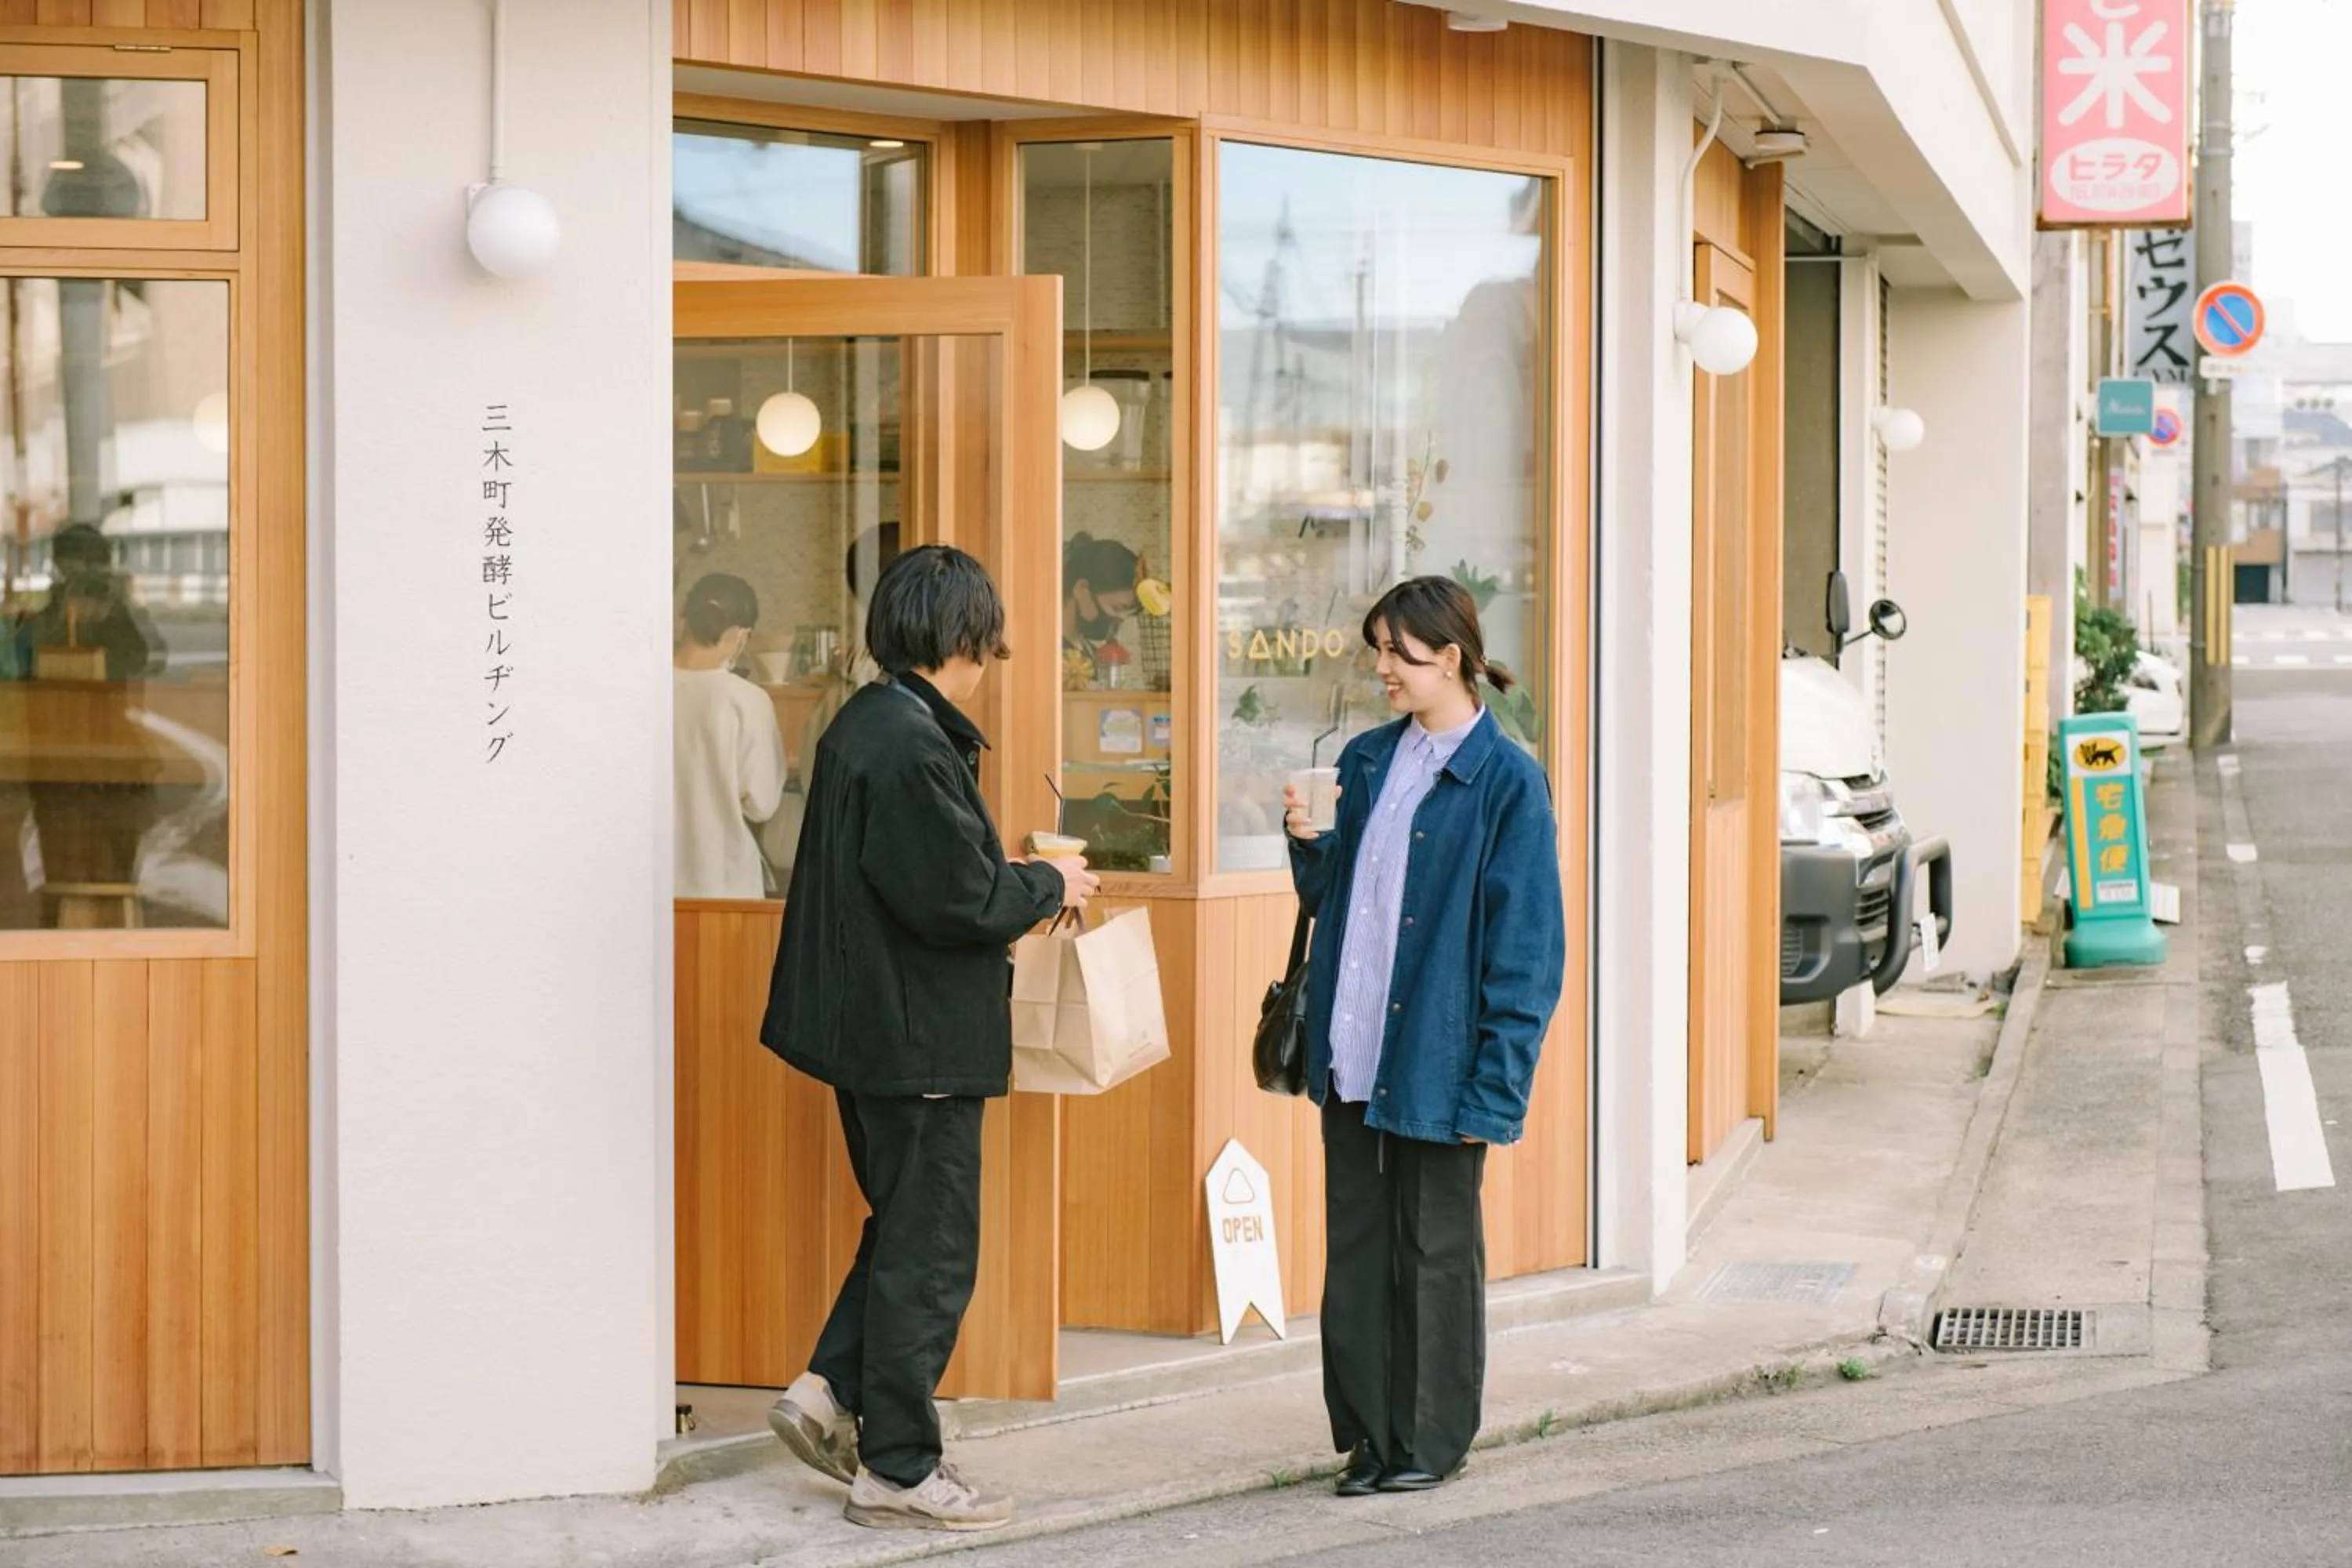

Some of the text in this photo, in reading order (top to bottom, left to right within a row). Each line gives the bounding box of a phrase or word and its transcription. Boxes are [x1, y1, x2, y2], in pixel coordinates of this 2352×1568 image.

[2058, 0, 2172, 129] 米
[2069, 154, 2162, 181] ヒラタ
[2135, 230, 2190, 367] ゼウス
[481, 405, 514, 764] 三木町発酵ビルヂング
[1228, 629, 1344, 659] SANDO
[2095, 782, 2130, 874] 宅急便
[1222, 1215, 1264, 1243] OPEN
